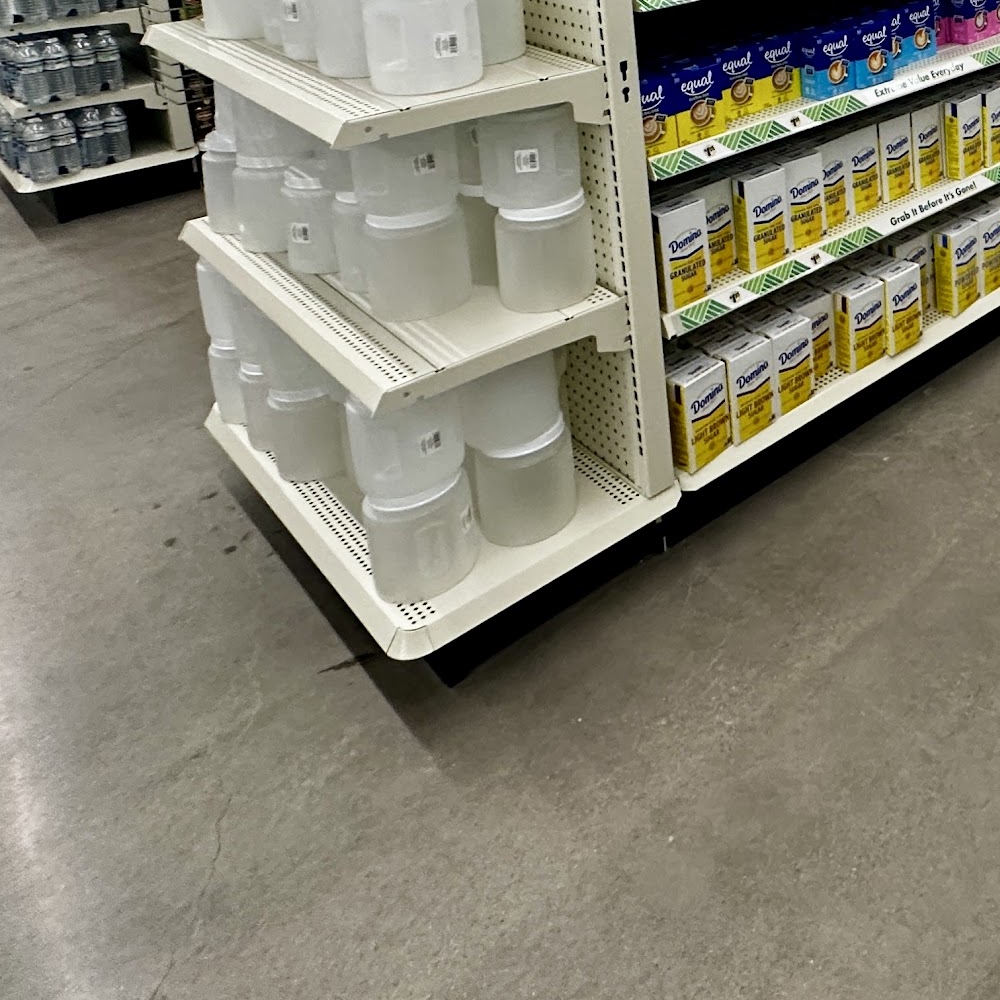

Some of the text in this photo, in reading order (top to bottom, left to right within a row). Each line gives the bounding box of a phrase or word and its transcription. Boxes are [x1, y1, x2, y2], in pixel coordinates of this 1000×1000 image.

[909, 6, 930, 24] equal
[823, 35, 848, 56] equal
[862, 26, 887, 46] equal
[764, 40, 792, 64] equal
[723, 51, 753, 75] equal
[681, 70, 714, 96] equal
[642, 84, 665, 104] ual
[918, 126, 938, 143] Domino
[963, 117, 980, 132] Domino
[887, 136, 908, 154] Domino
[852, 148, 875, 166] Domino
[790, 178, 819, 199] Domino
[753, 196, 782, 218] Domino
[890, 182, 977, 226] Grab It Before It's Gone!
[791, 207, 822, 223] GRANULATED
[669, 229, 702, 254] Domino
[753, 224, 785, 242] GRANULATED
[955, 237, 977, 259] Domino
[670, 259, 705, 280] GRANULATED
[893, 283, 917, 307] Domino
[811, 313, 828, 331] mino
[855, 302, 882, 325] Domino
[779, 338, 809, 365] Domino
[736, 360, 768, 389] Domino
[794, 369, 813, 388] BROWN
[691, 383, 723, 414] Domino
[737, 392, 773, 419] LIGHT BROWN
[692, 415, 731, 445] LIGHT BROWN
